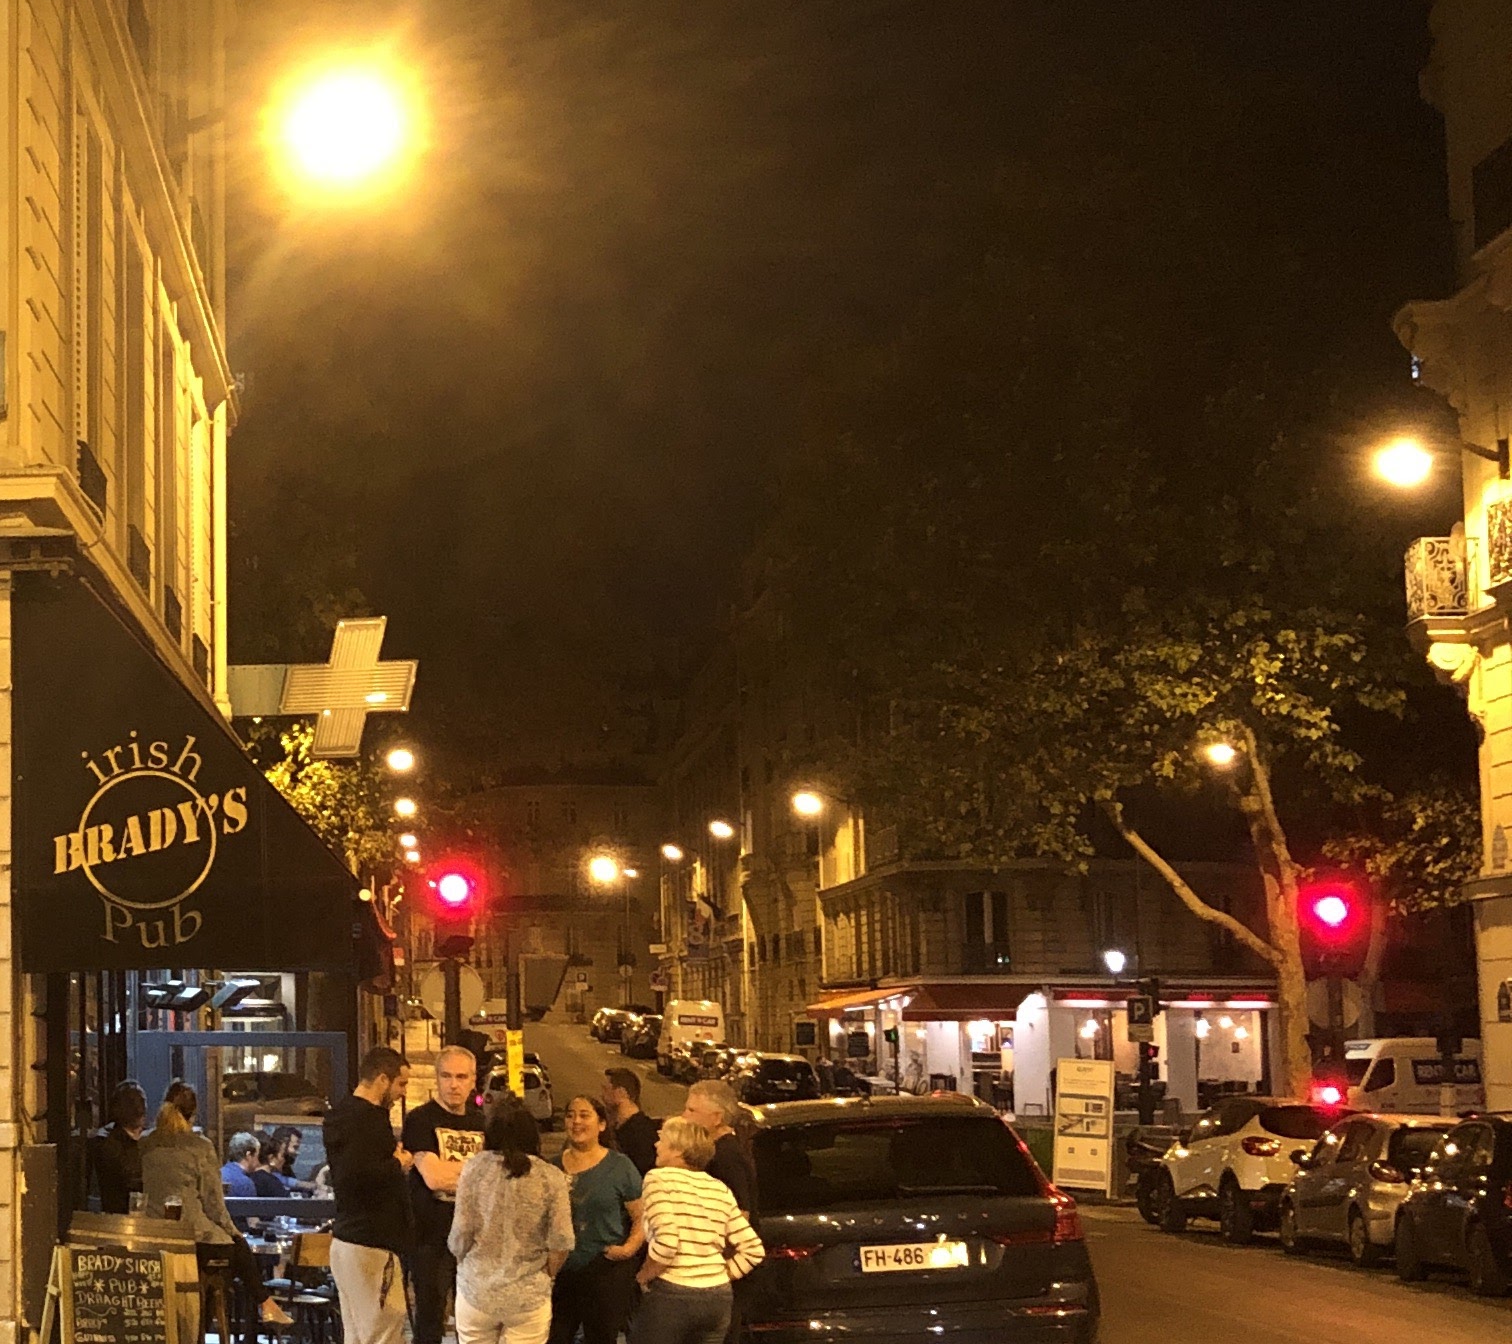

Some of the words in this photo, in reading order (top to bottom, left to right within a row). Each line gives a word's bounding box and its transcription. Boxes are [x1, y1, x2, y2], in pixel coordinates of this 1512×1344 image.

[81, 729, 203, 786] irish
[53, 786, 248, 874] BRADY'S
[99, 895, 204, 949] Pub
[109, 1278, 138, 1293] PUB
